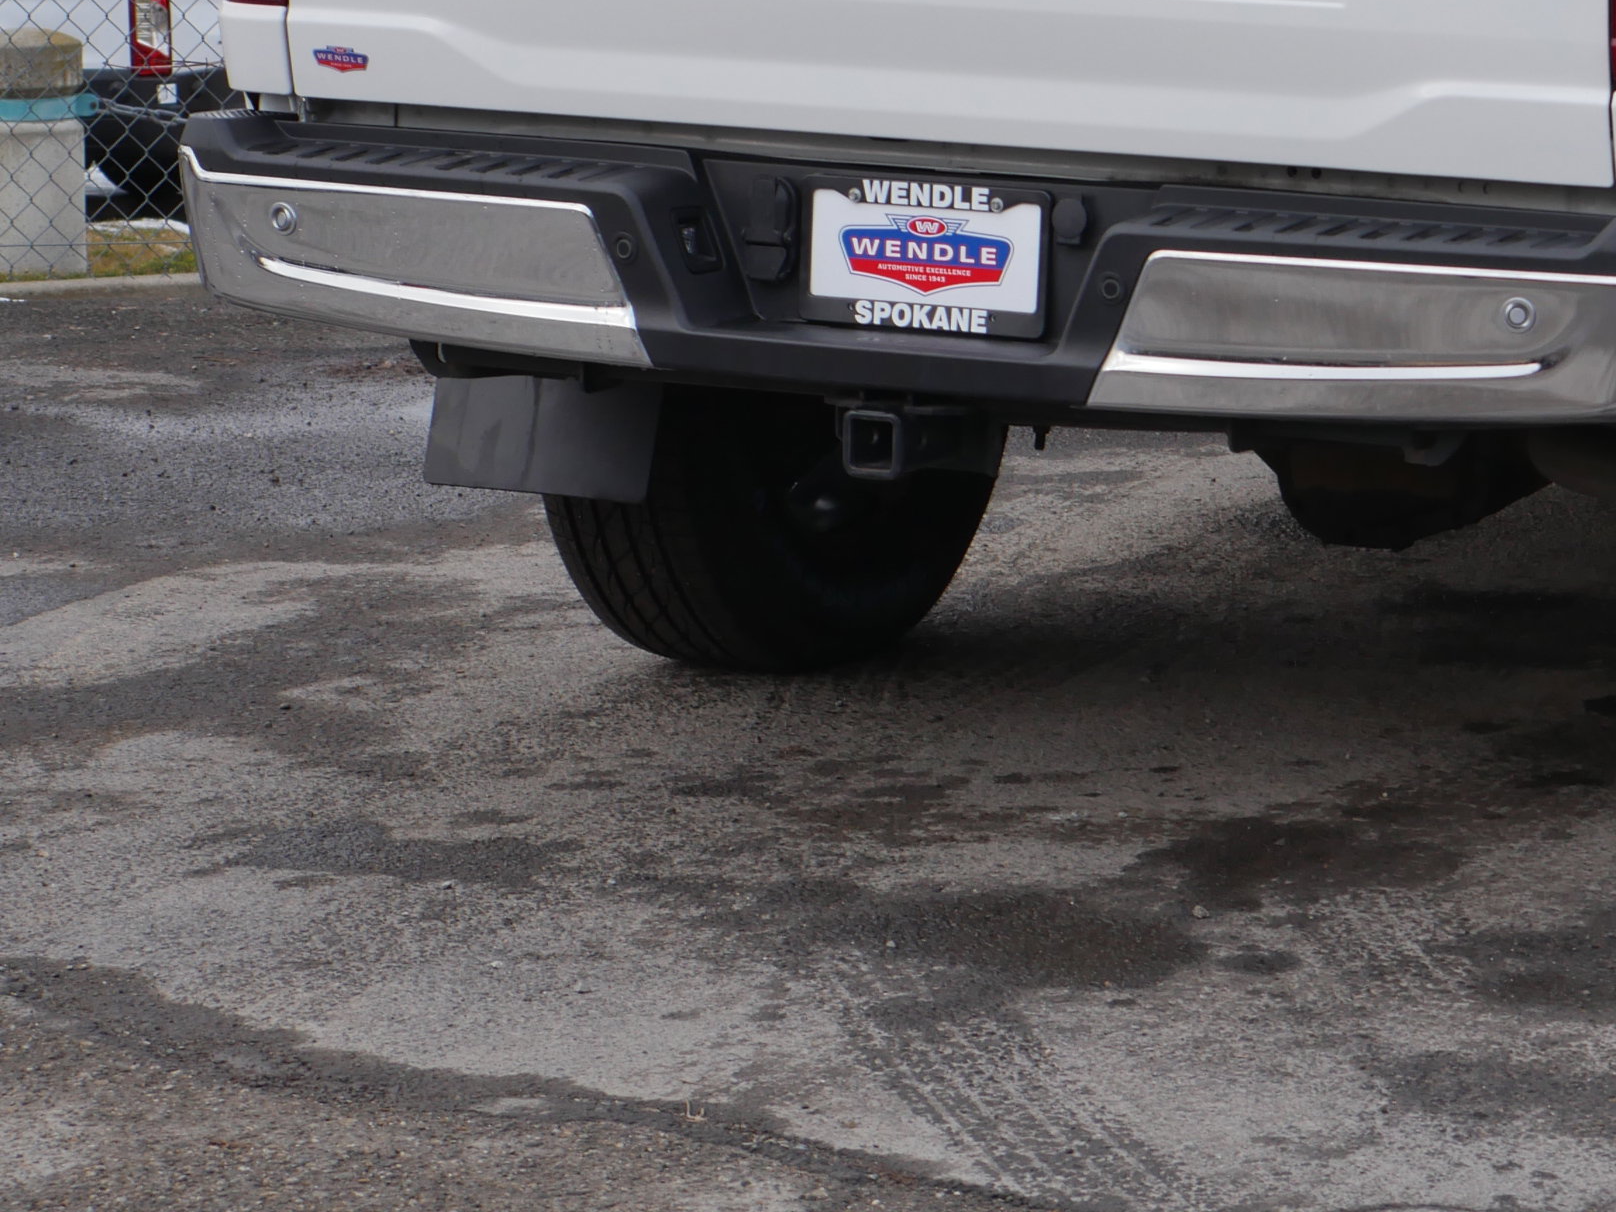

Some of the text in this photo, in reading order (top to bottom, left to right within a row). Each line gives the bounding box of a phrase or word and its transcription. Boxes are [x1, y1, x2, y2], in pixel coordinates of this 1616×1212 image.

[316, 52, 364, 64] WENDLE
[862, 179, 990, 212] WENDLE
[915, 221, 939, 234] W
[851, 237, 997, 266] WENDLE
[877, 263, 972, 277] AUTOMOTIVE EXCELLENCE
[905, 273, 946, 284] SINCE 1943
[854, 299, 988, 335] SPOKANE
